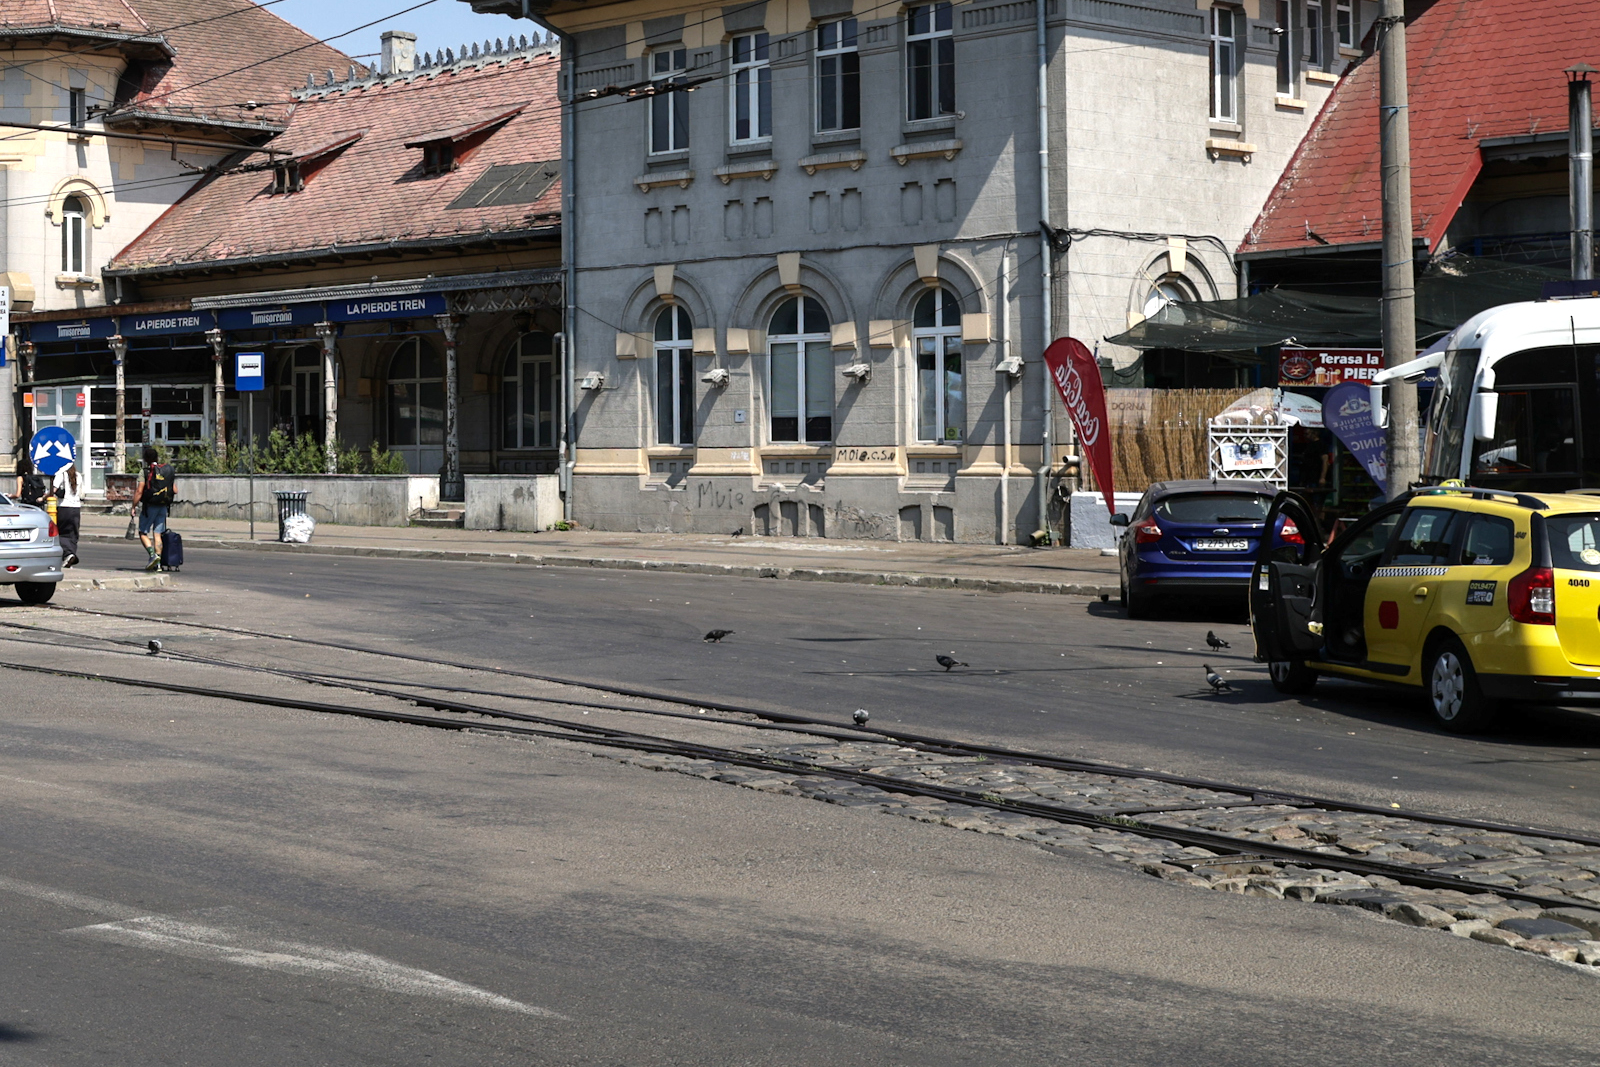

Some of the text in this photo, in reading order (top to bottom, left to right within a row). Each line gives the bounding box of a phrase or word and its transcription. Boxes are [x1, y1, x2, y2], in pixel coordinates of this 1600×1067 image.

[347, 299, 426, 315] LA PIERDE TREN
[136, 317, 199, 330] LA PIERDE TREN
[1319, 353, 1379, 365] Terasa la
[1344, 367, 1385, 379] PIER
[1111, 402, 1147, 411] DORNA
[1197, 539, 1204, 547] B
[1568, 579, 1590, 587] 4040
